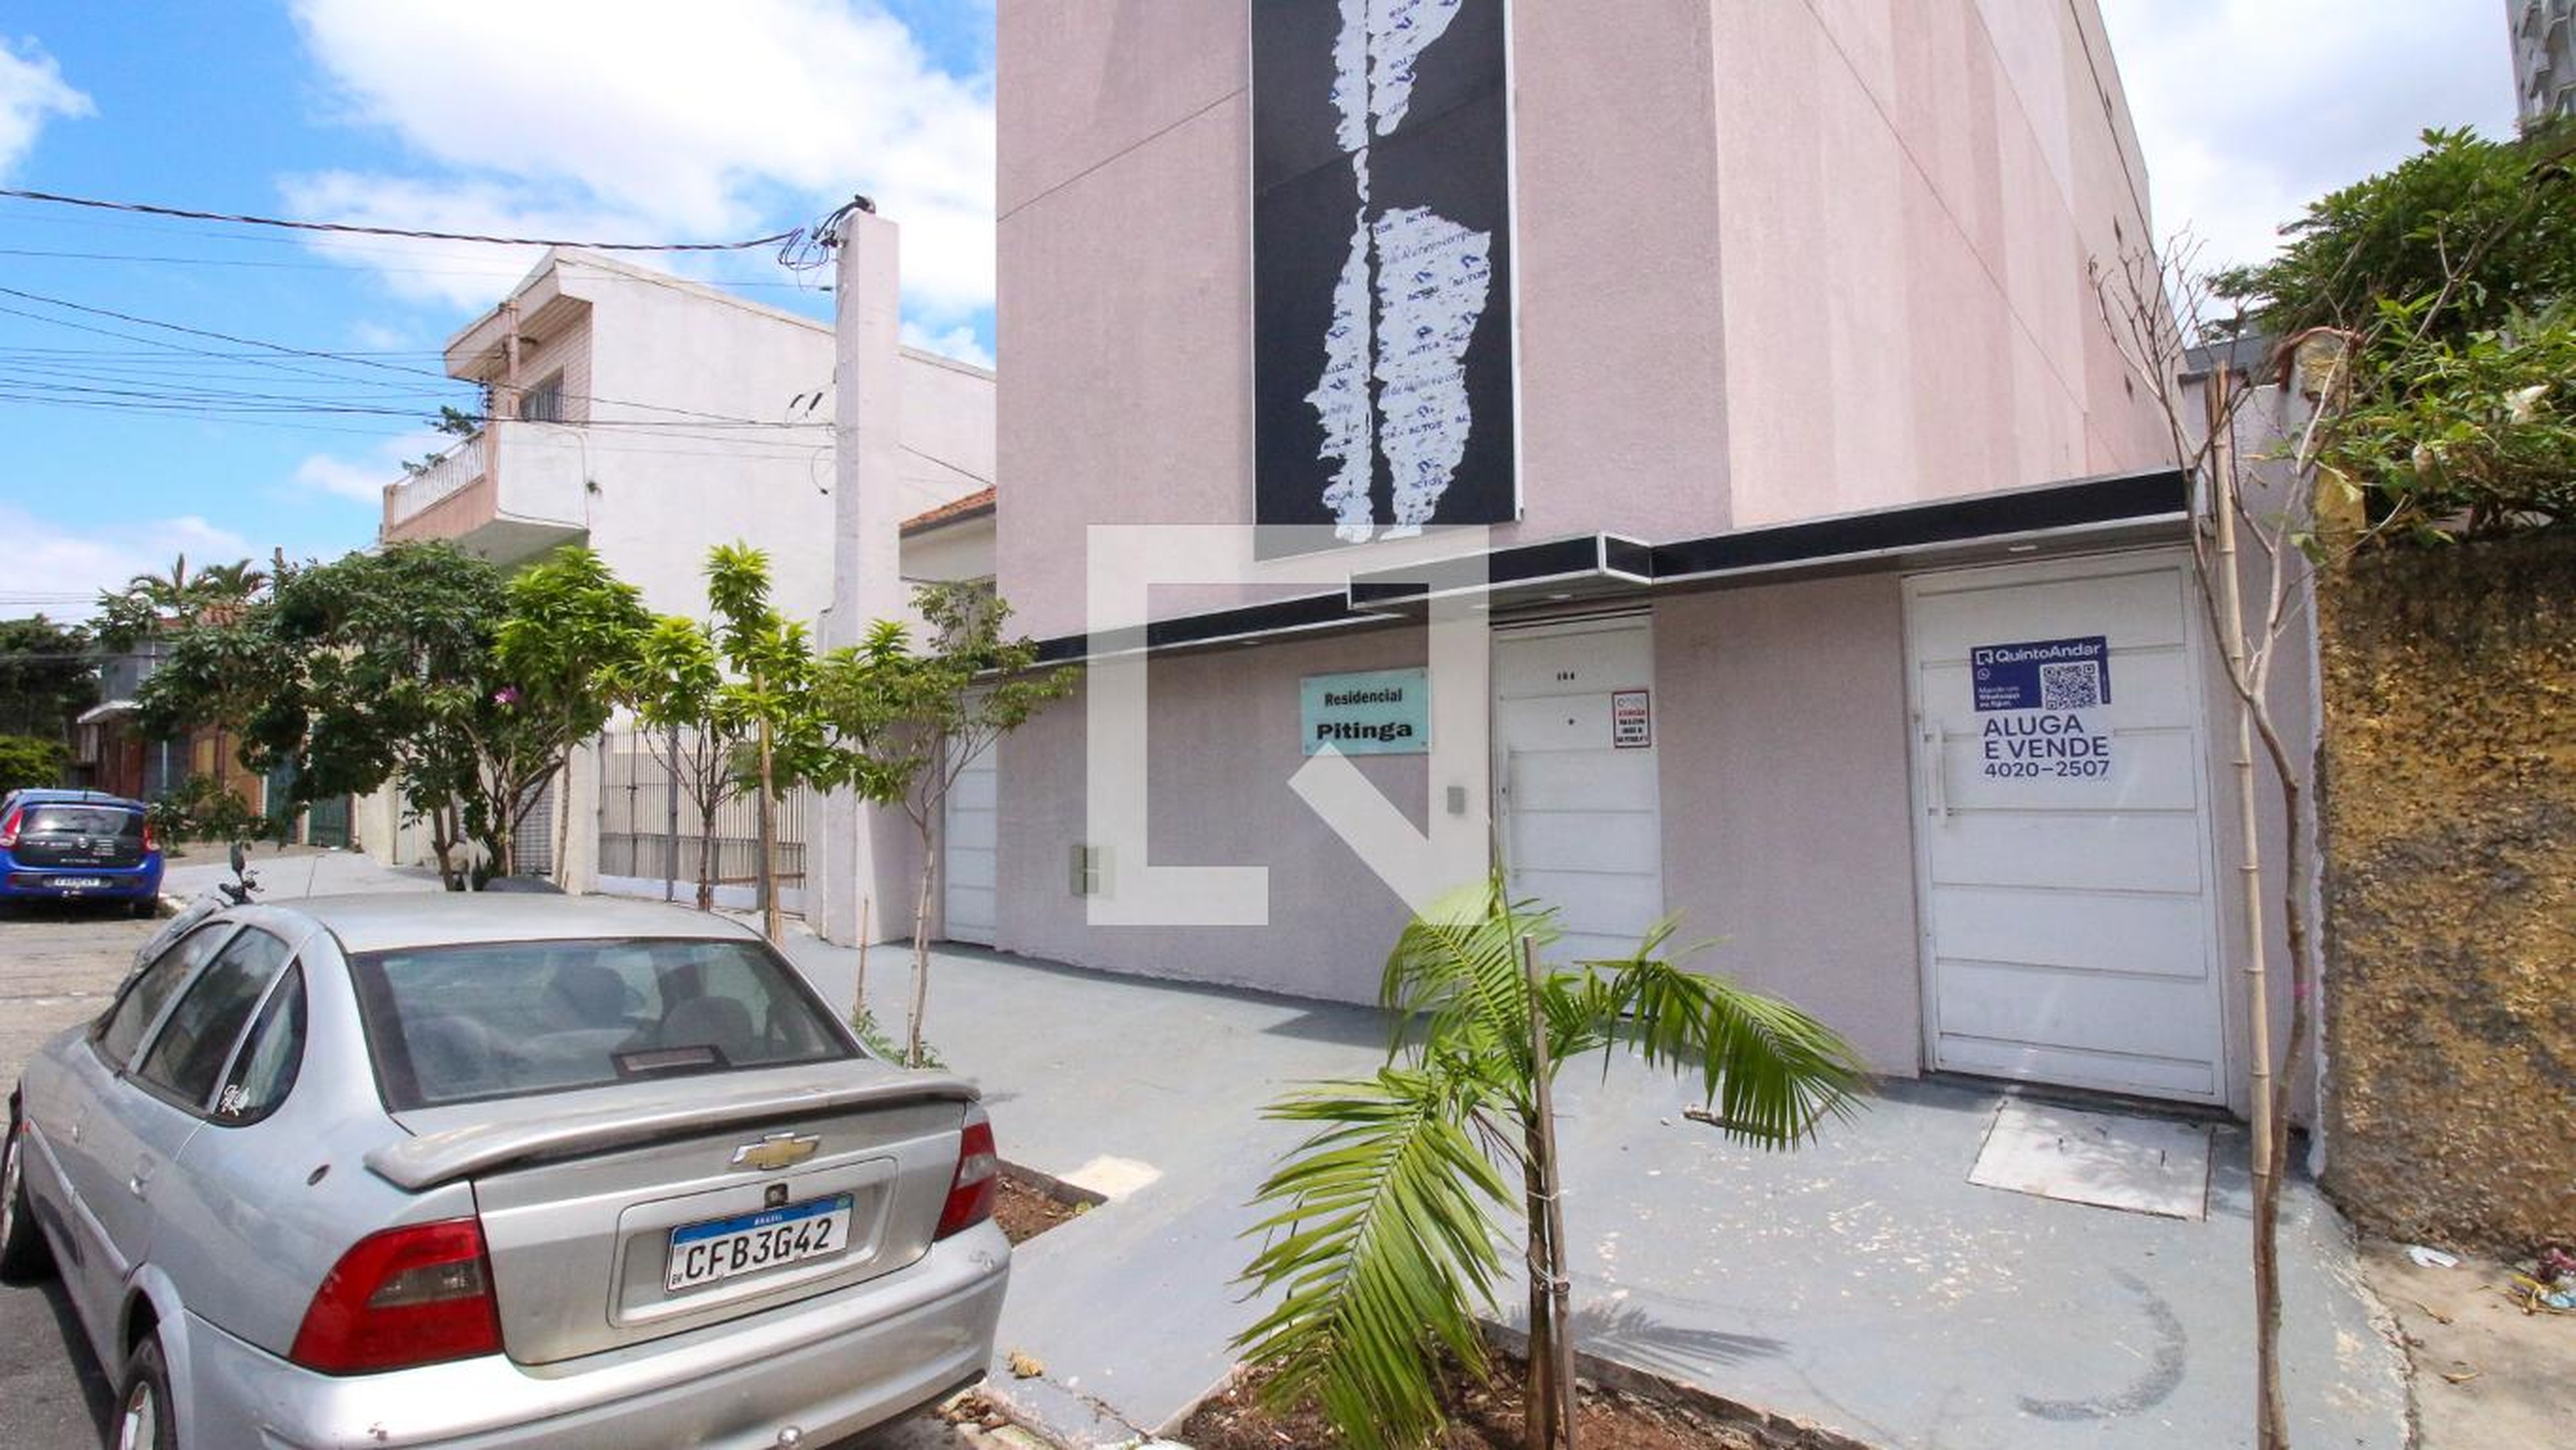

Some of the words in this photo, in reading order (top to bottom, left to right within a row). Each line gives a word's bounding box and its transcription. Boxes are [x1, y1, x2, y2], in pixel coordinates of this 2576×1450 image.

[1995, 643, 2102, 662] QuintoAndar
[1324, 688, 1403, 707] Residencial
[1316, 722, 1413, 741] Pitinga
[1983, 715, 2084, 737] ALUGA
[1985, 741, 2000, 760] E
[2007, 736, 2109, 759] VENDE
[1984, 760, 2110, 778] 4020-2507
[685, 1216, 833, 1279] CFB3G42
